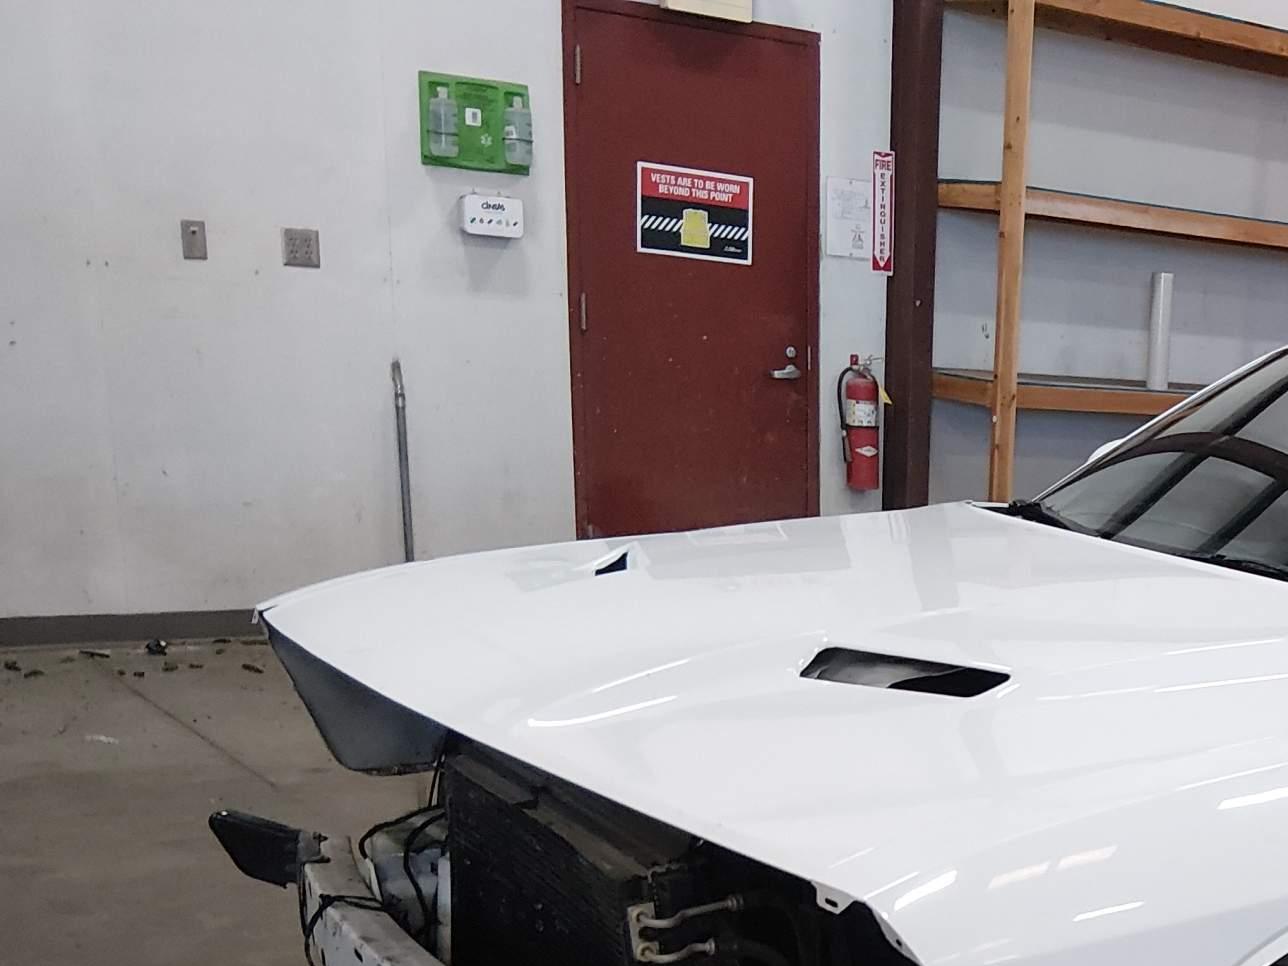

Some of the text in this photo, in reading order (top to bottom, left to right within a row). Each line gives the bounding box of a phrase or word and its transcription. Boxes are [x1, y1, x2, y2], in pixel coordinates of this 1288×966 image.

[875, 159, 891, 171] FIRE
[650, 173, 740, 194] VESTS ARE TO BE WORN
[659, 184, 734, 202] BEYOND THIS POINT
